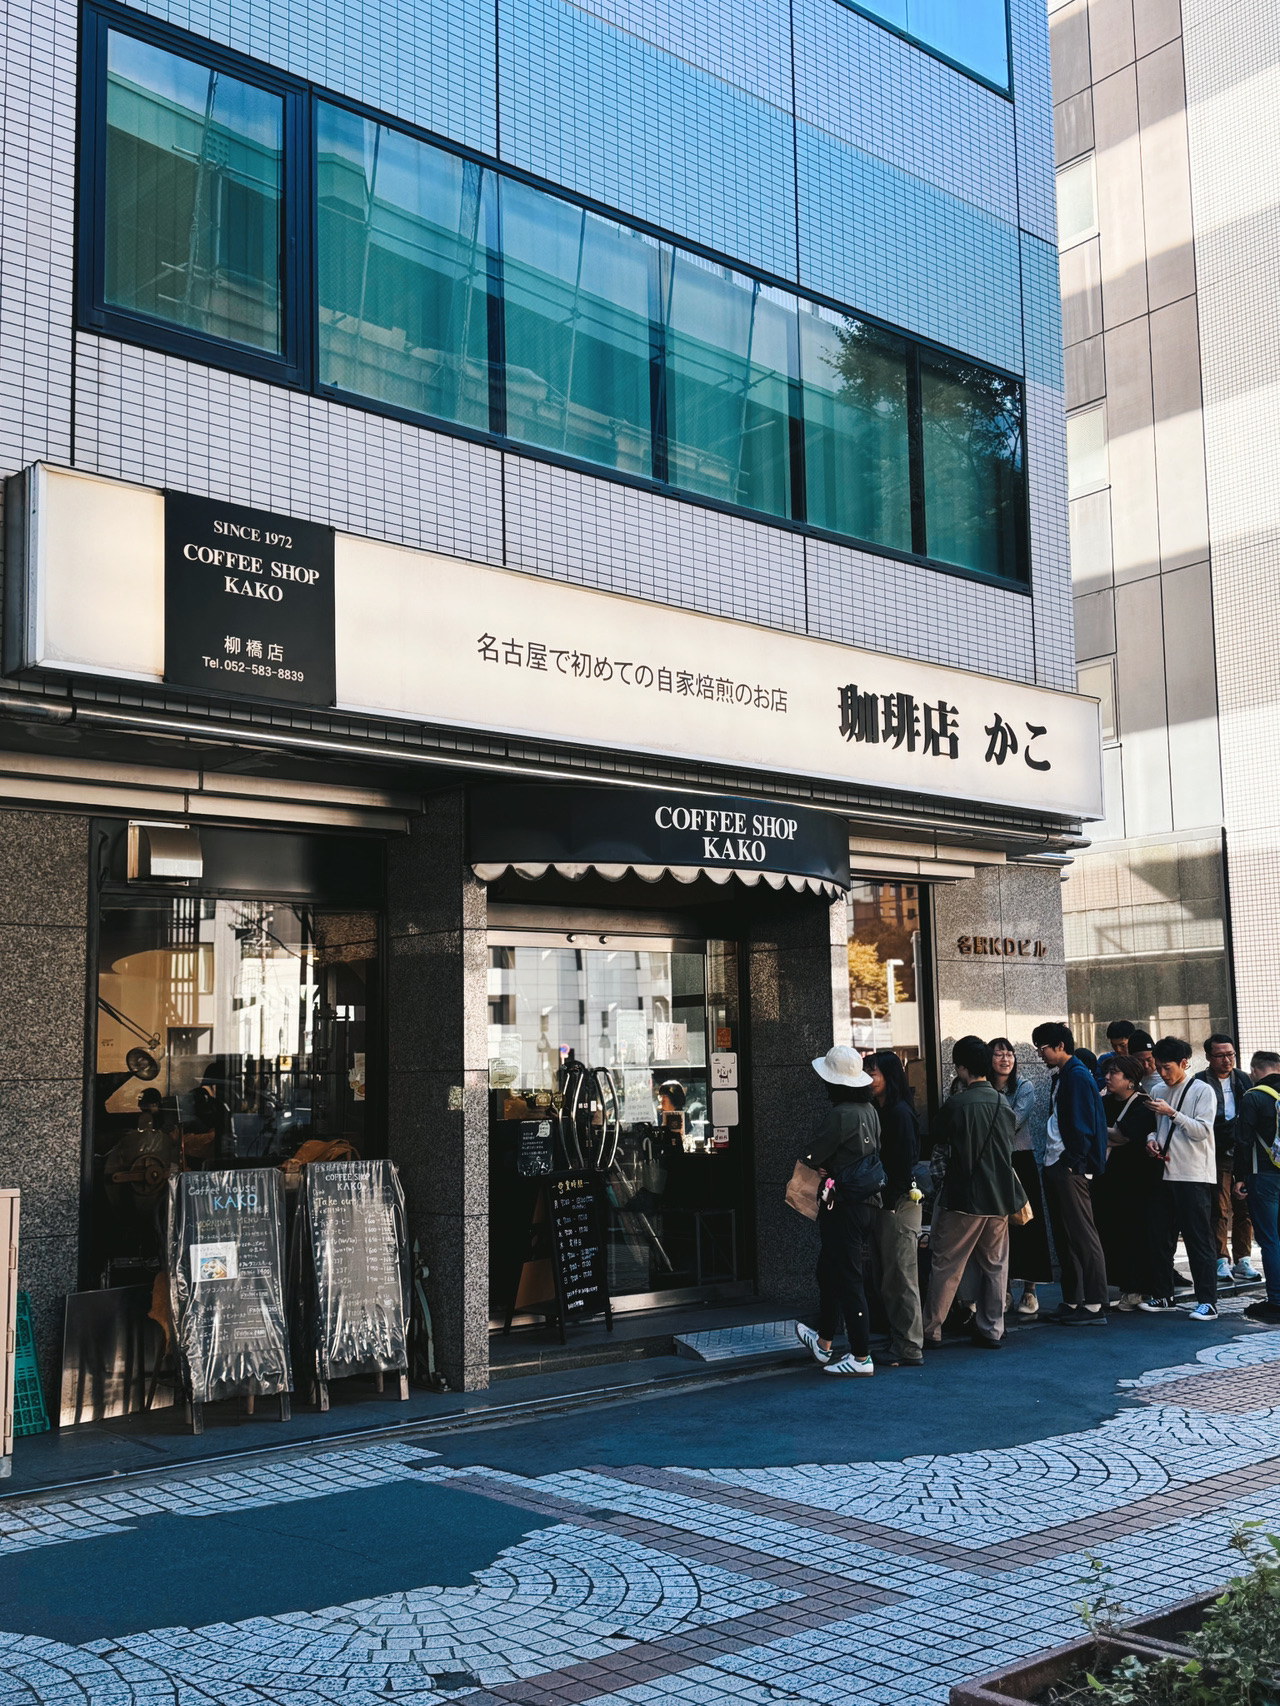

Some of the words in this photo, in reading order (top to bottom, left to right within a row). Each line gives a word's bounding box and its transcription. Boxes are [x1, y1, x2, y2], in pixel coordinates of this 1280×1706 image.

[213, 520, 261, 542] SINCE
[264, 531, 293, 549] 1972
[183, 543, 263, 575] COFFEE
[270, 561, 320, 585] SHOP
[224, 575, 284, 602] KAKO
[223, 635, 284, 662] 柳橋店
[477, 632, 788, 713] 名古屋で初めての自家焙煎のお店
[837, 683, 960, 760] 珈琲店
[984, 712, 1052, 772] かこ
[655, 806, 748, 835] COFFEE
[752, 814, 798, 841] SHOP
[702, 836, 766, 863] KAKO
[957, 935, 1049, 958] 名駅KDビル
[188, 1185, 220, 1196] Coffee
[225, 1184, 257, 1195] house
[325, 1173, 352, 1182] COFFEE
[337, 1182, 363, 1191] KAKO
[214, 1194, 258, 1211] KAKO
[318, 1195, 338, 1207] Take
